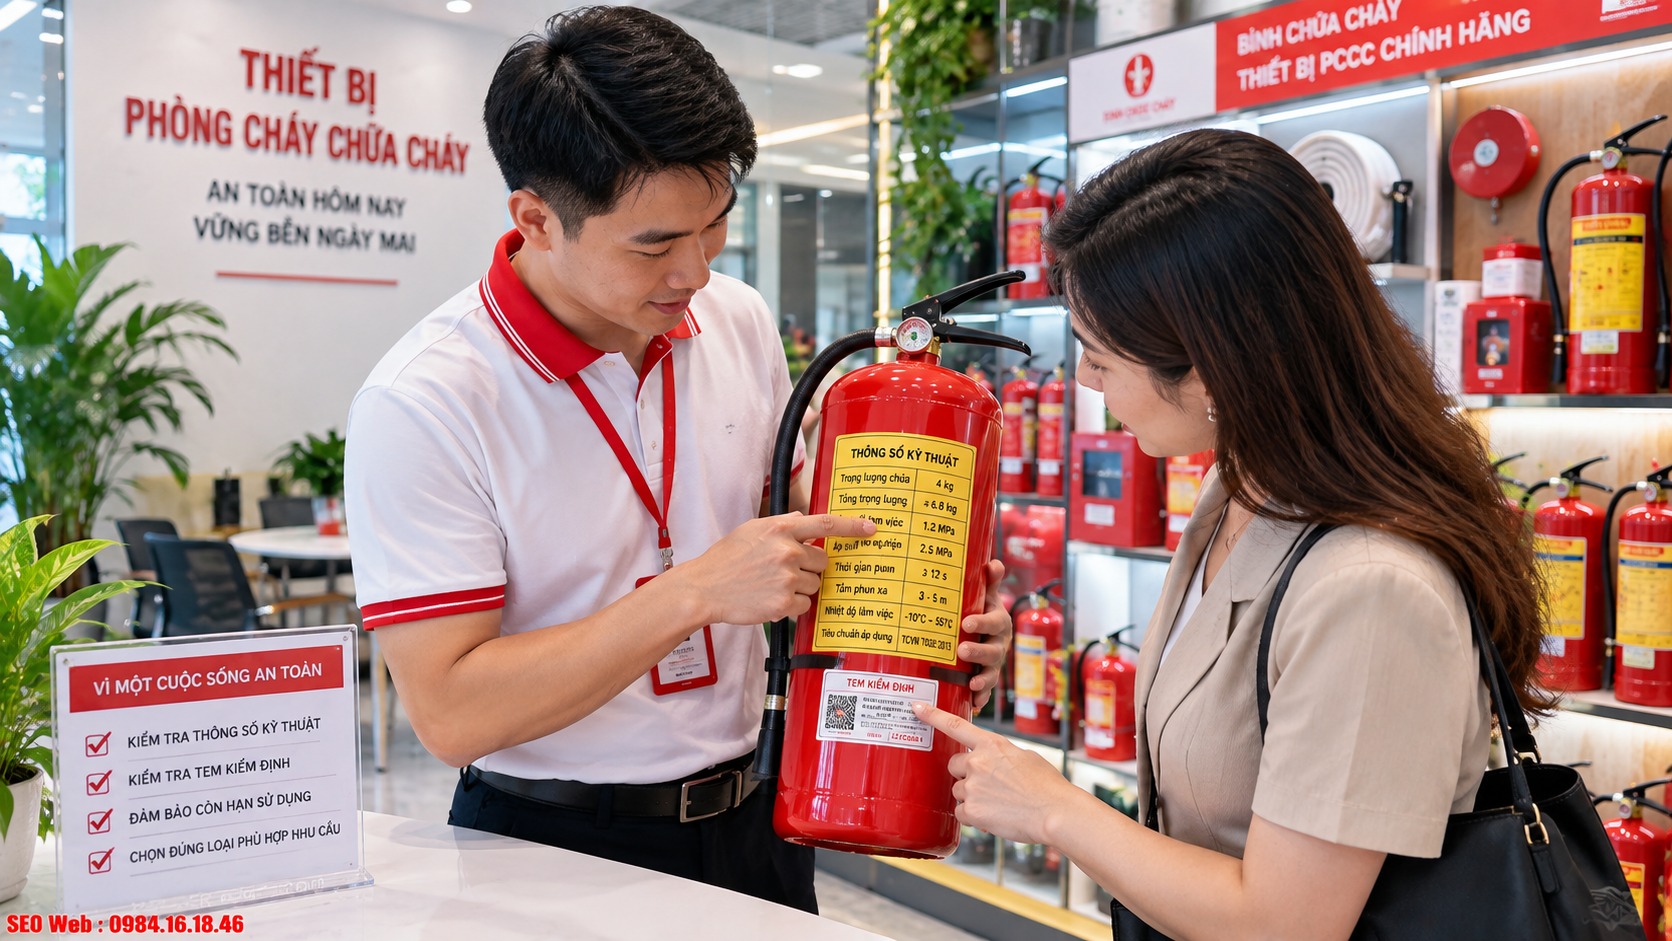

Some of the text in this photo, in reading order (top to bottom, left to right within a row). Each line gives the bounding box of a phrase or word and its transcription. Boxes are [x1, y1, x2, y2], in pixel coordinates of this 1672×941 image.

[1236, 9, 1531, 92] THIẾT BỊ PCCC CHÍNH HÃNG
[240, 47, 377, 115] THIẾT BỊ
[125, 94, 470, 173] PHÒNG CHÁY CHỮA CHÁY
[207, 180, 406, 218] AN TOÀN HÔM NAY
[317, 224, 373, 249] NGÀY
[379, 232, 417, 253] MAI
[936, 479, 954, 492] 4 kg
[923, 521, 955, 536] 1.2 MPa
[931, 569, 940, 579] 12
[853, 584, 875, 595] phun
[877, 587, 888, 595] xa
[919, 591, 924, 600] 3
[940, 596, 947, 605] m
[115, 674, 152, 696] MỘT
[156, 670, 202, 692] CUỘC
[207, 666, 250, 686] SỐNG
[254, 667, 276, 682] AN
[280, 661, 322, 680] TOÀN
[847, 678, 865, 688] TEM
[164, 731, 189, 745] TRA
[192, 725, 238, 743] THÔNG
[165, 769, 191, 782] TRA
[195, 765, 222, 779] TEM
[259, 757, 290, 774] ĐỊNH
[196, 800, 223, 816] CÒN
[226, 797, 253, 814] HẠN
[277, 790, 312, 807] DỤNG
[129, 847, 166, 864] CHỌN
[169, 841, 204, 859] ĐÚNG
[207, 837, 234, 853] LOẠI
[264, 829, 288, 844] HỢP
